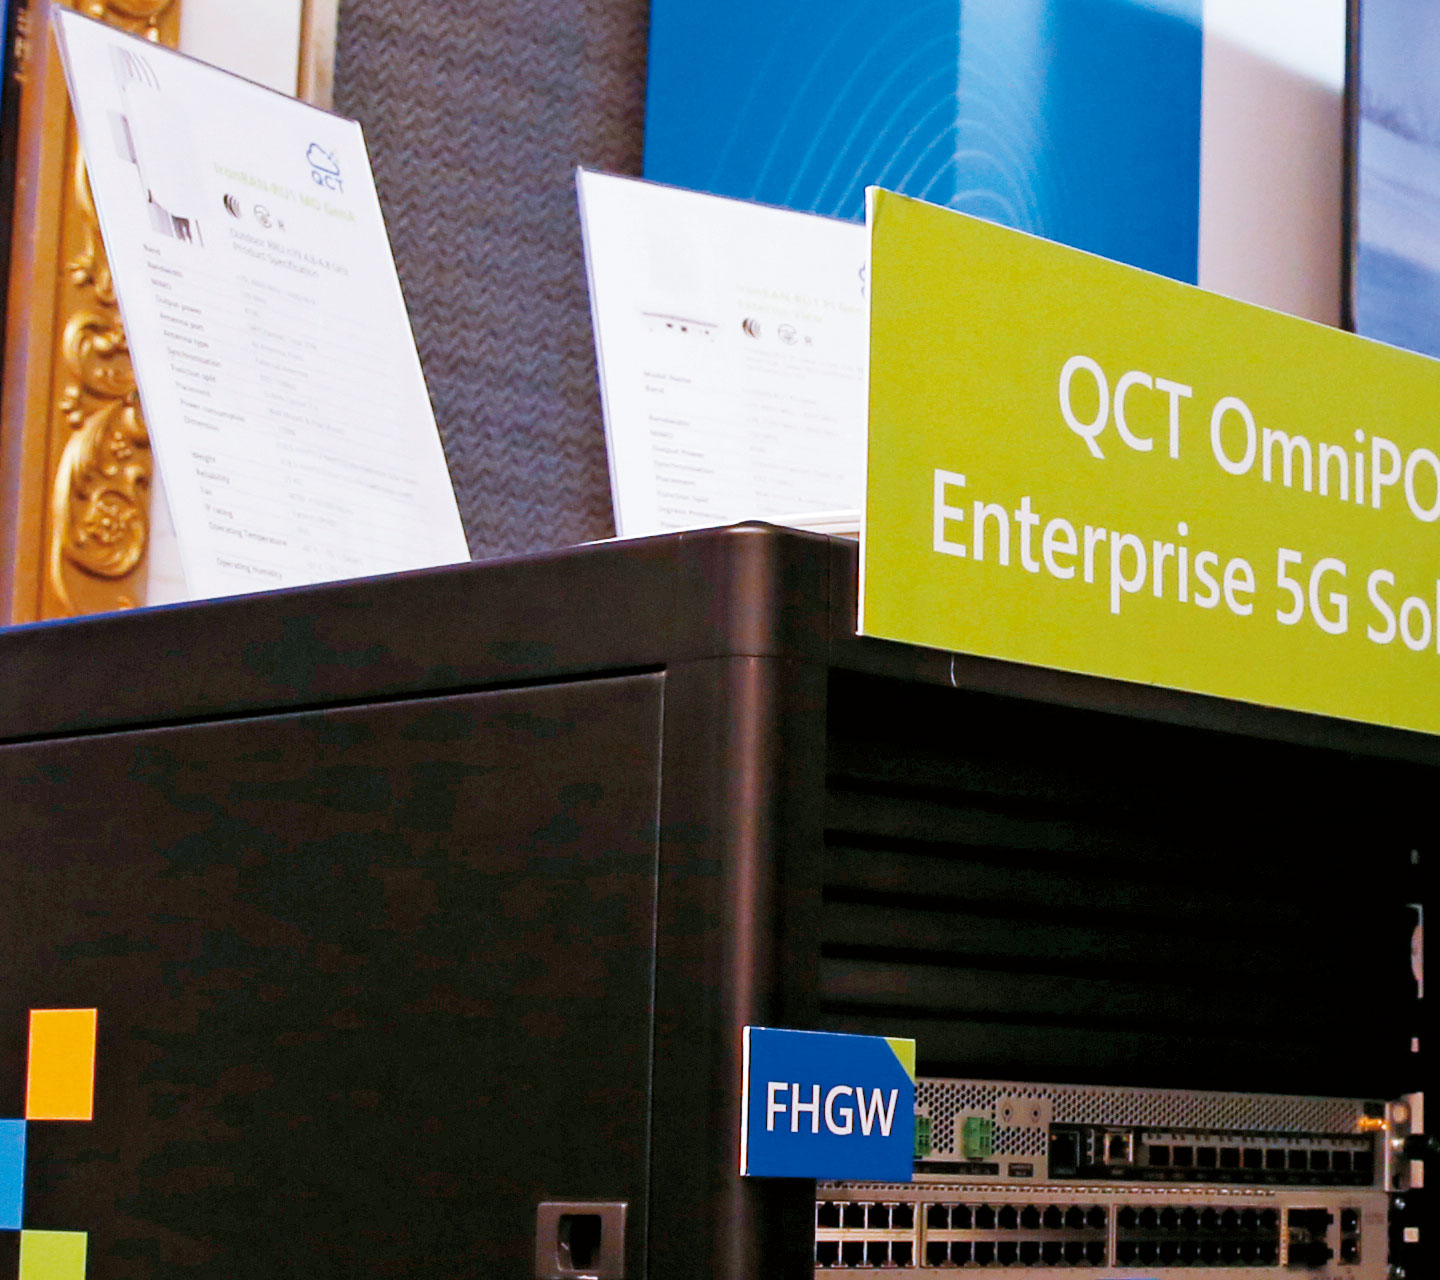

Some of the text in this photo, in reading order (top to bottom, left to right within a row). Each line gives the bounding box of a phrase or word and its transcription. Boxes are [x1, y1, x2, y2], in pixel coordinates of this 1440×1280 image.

[311, 171, 345, 194] QCT
[1059, 355, 1192, 459] QCT
[932, 468, 1256, 615] Enterprise
[1276, 548, 1348, 635] 5G
[765, 1081, 898, 1138] FHGW
